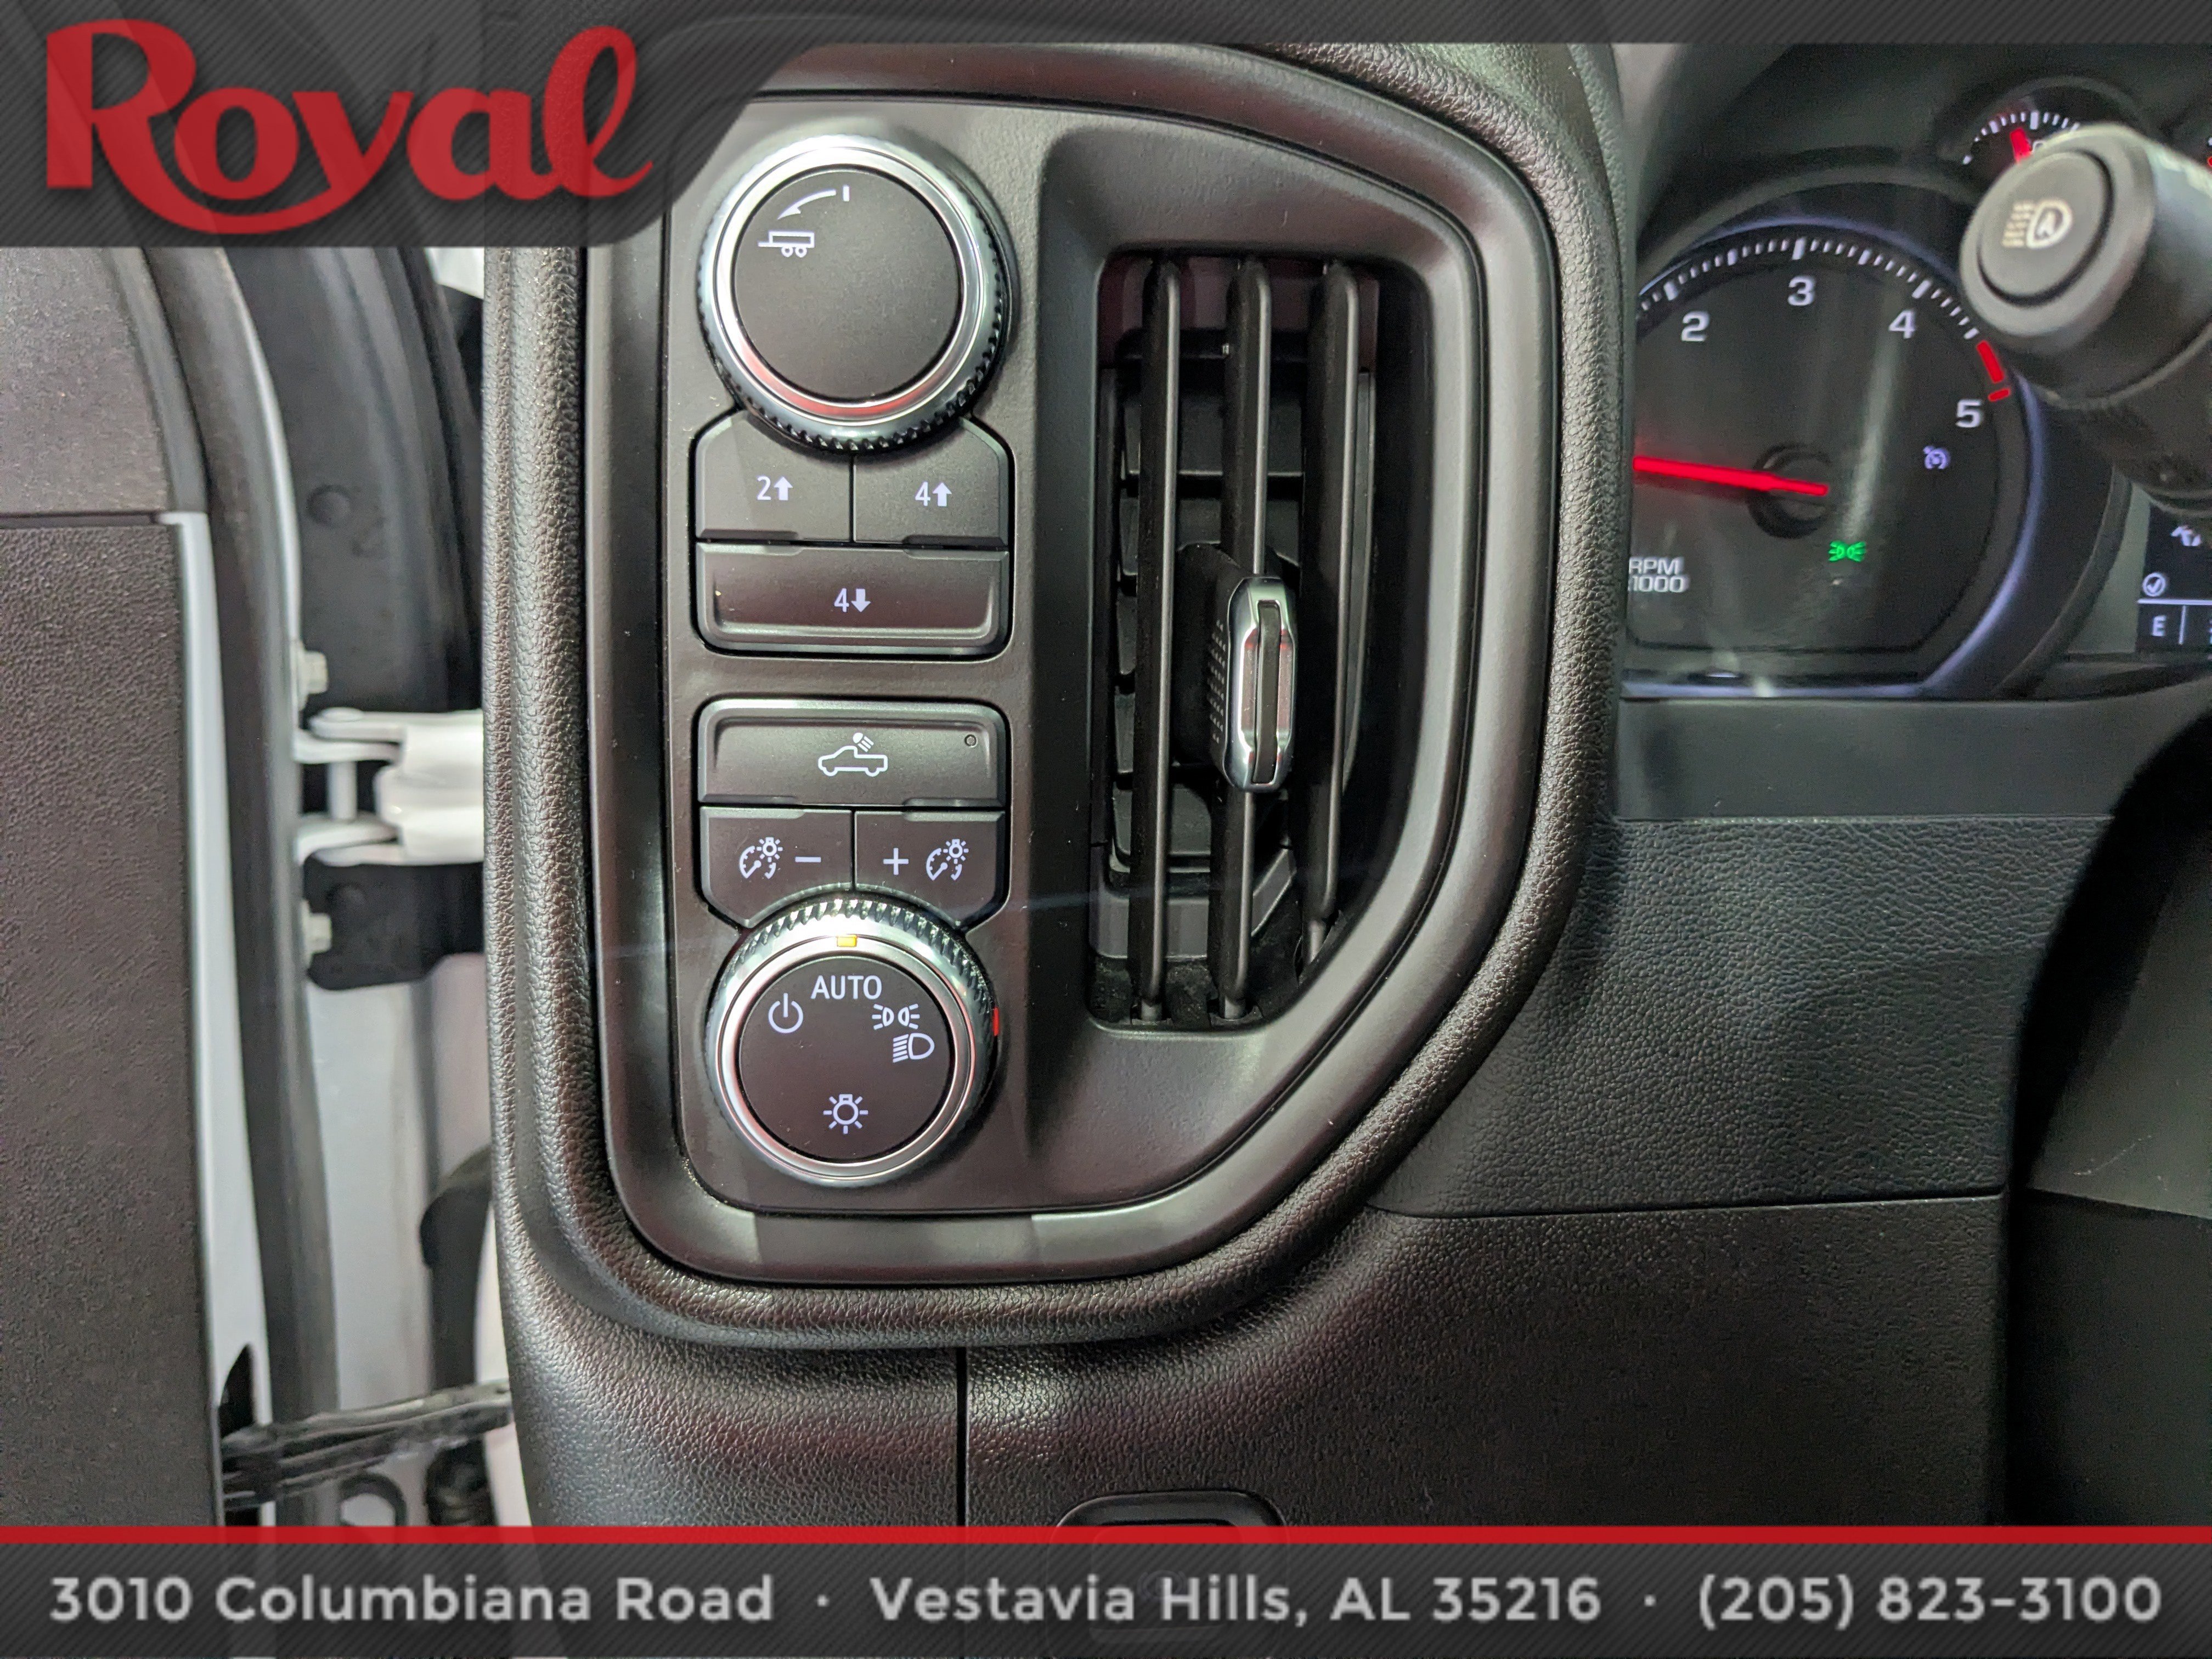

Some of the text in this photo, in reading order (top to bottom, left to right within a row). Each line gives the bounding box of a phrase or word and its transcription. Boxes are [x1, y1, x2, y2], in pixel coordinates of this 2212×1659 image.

[1788, 276, 1815, 307] 3
[1680, 312, 1709, 342] 2
[1888, 309, 1916, 339] 4
[1955, 399, 1982, 429] 5
[757, 476, 772, 501] 2
[915, 481, 932, 507] 4
[1629, 556, 1683, 575] RPM
[833, 588, 850, 612] 4
[2152, 615, 2166, 637] E
[810, 974, 883, 1000] AUTO
